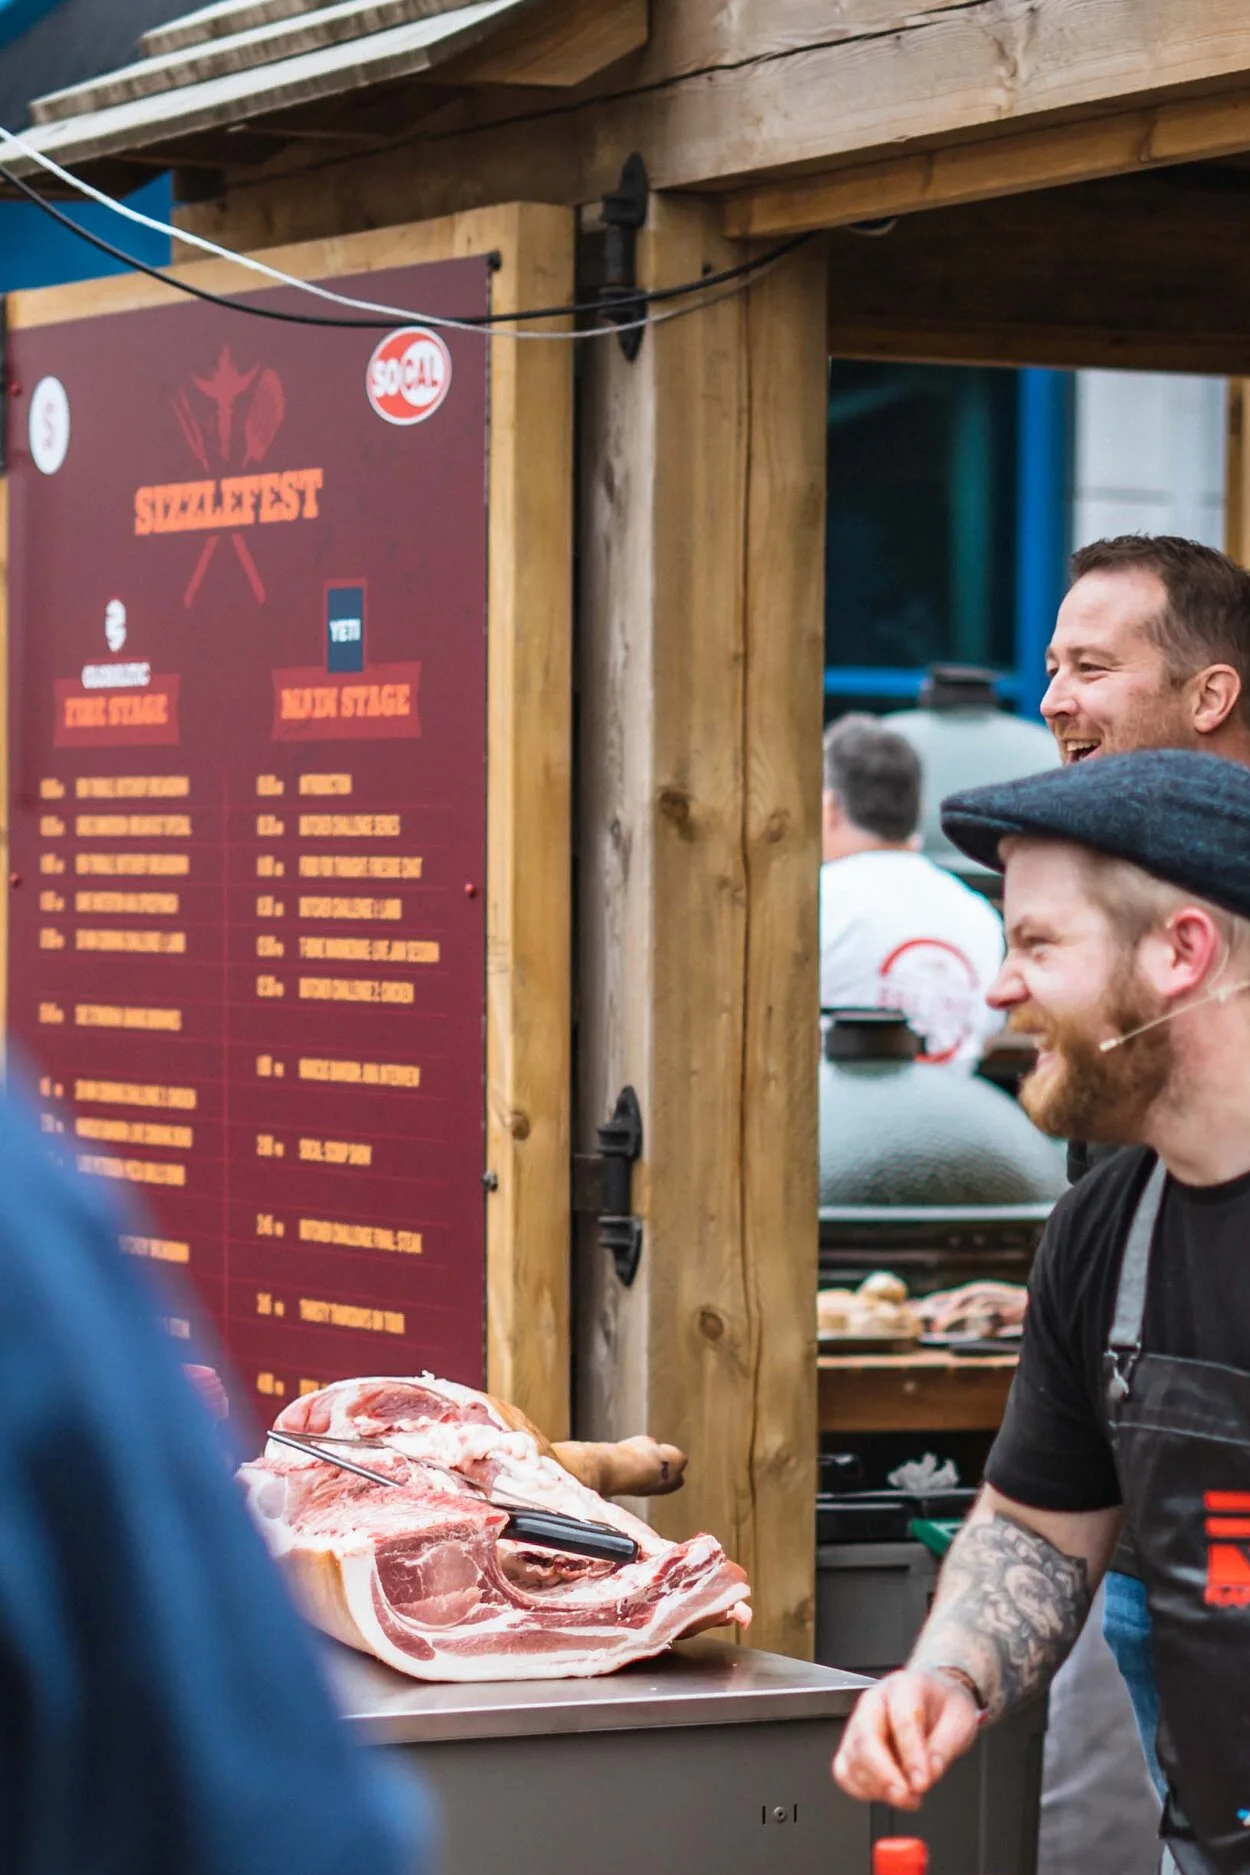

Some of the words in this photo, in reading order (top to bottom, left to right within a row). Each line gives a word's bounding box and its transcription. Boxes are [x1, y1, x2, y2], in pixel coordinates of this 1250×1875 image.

[134, 467, 323, 536] SIZZLEFEST
[329, 618, 361, 643] YETI
[108, 694, 168, 725] STAGE
[280, 686, 338, 720] MAIN
[340, 683, 410, 718] STAGE
